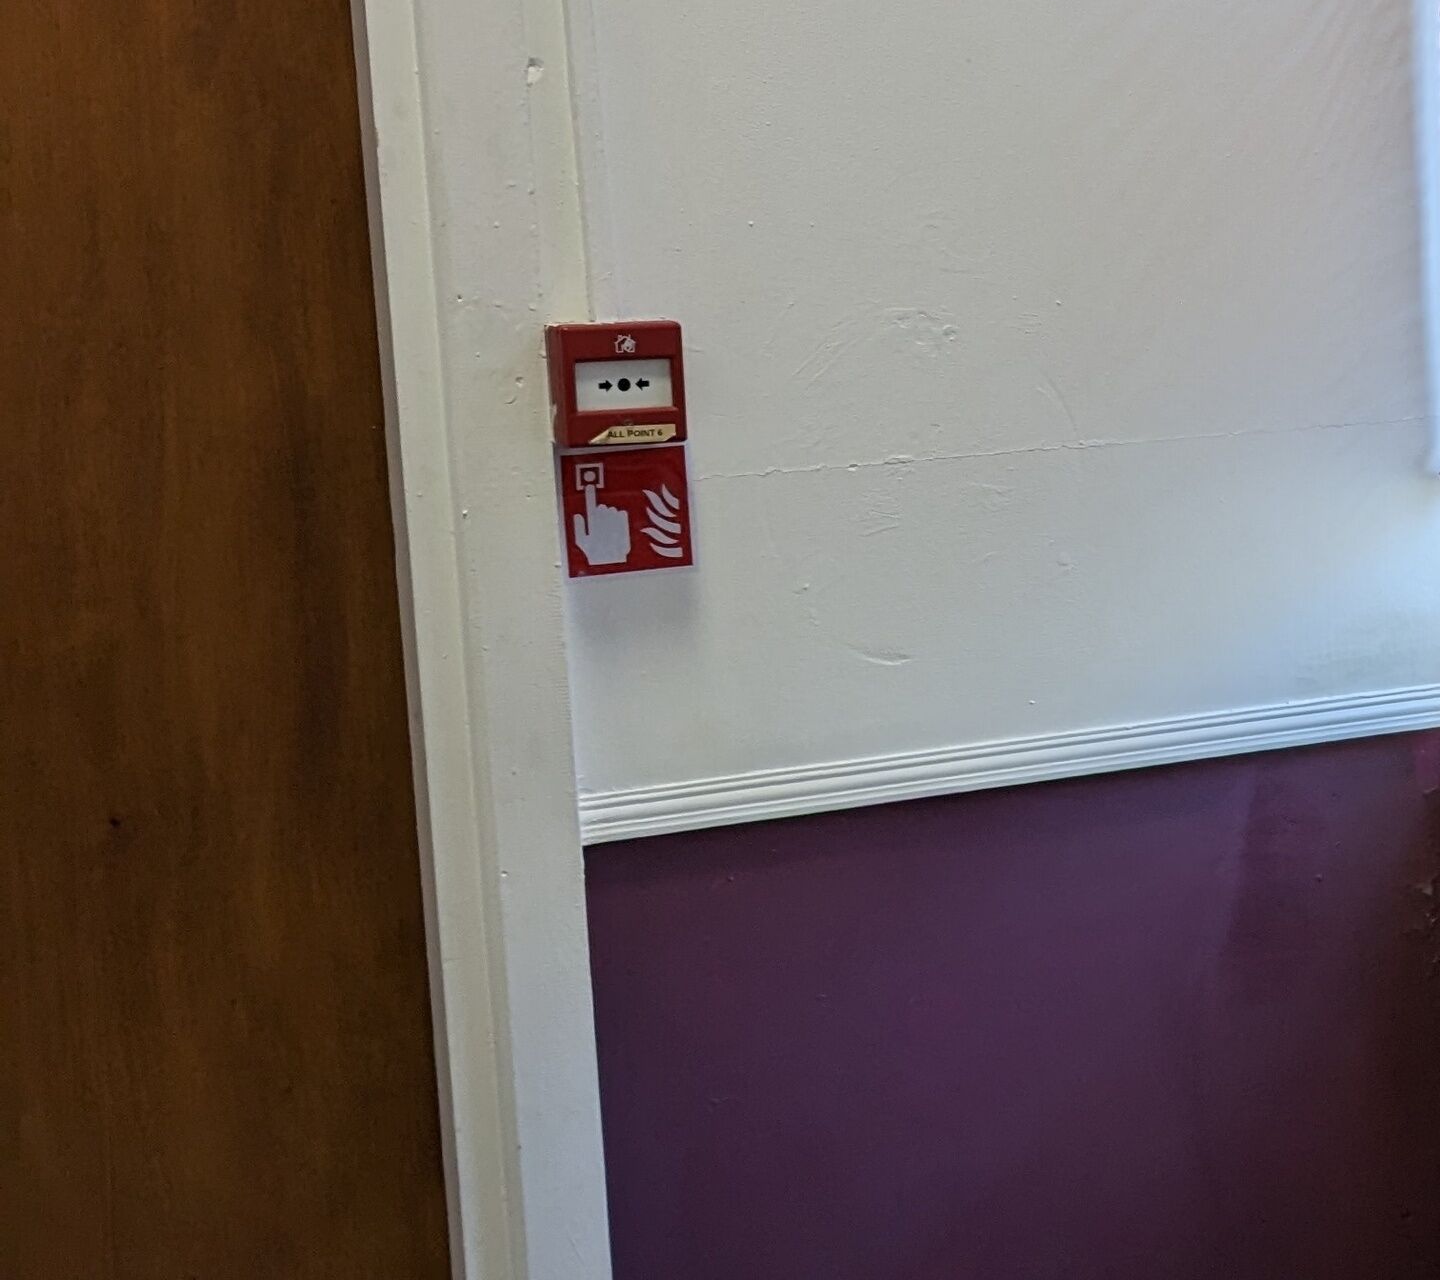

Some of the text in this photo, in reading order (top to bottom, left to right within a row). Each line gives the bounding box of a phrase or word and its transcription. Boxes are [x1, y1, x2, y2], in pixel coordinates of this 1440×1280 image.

[608, 428, 663, 438] ALL POINT 6
